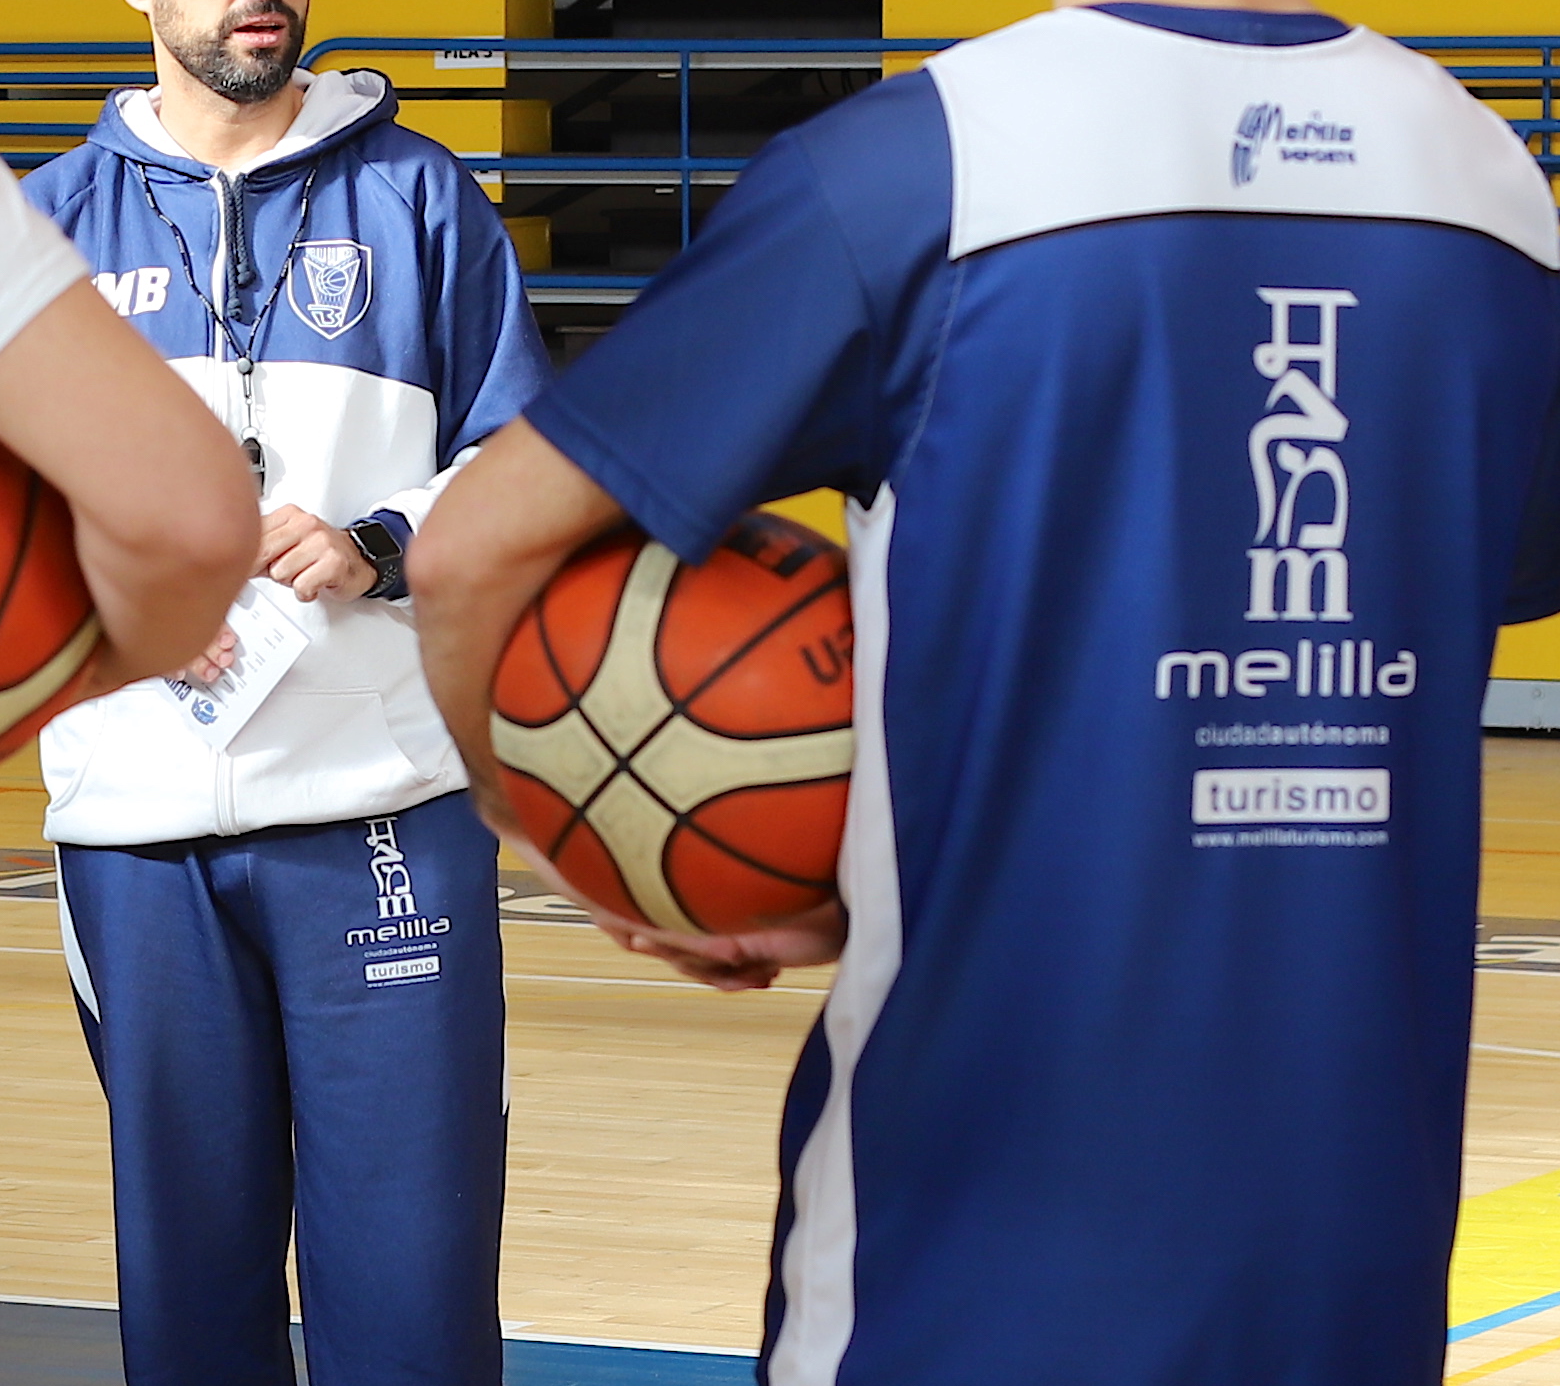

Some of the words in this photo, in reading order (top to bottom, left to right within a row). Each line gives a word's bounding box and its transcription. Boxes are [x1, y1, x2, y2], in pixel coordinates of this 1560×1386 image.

[1154, 638, 1418, 700] melilla
[1210, 778, 1379, 812] turismo
[346, 917, 451, 946] melilla
[371, 961, 435, 979] turismo
